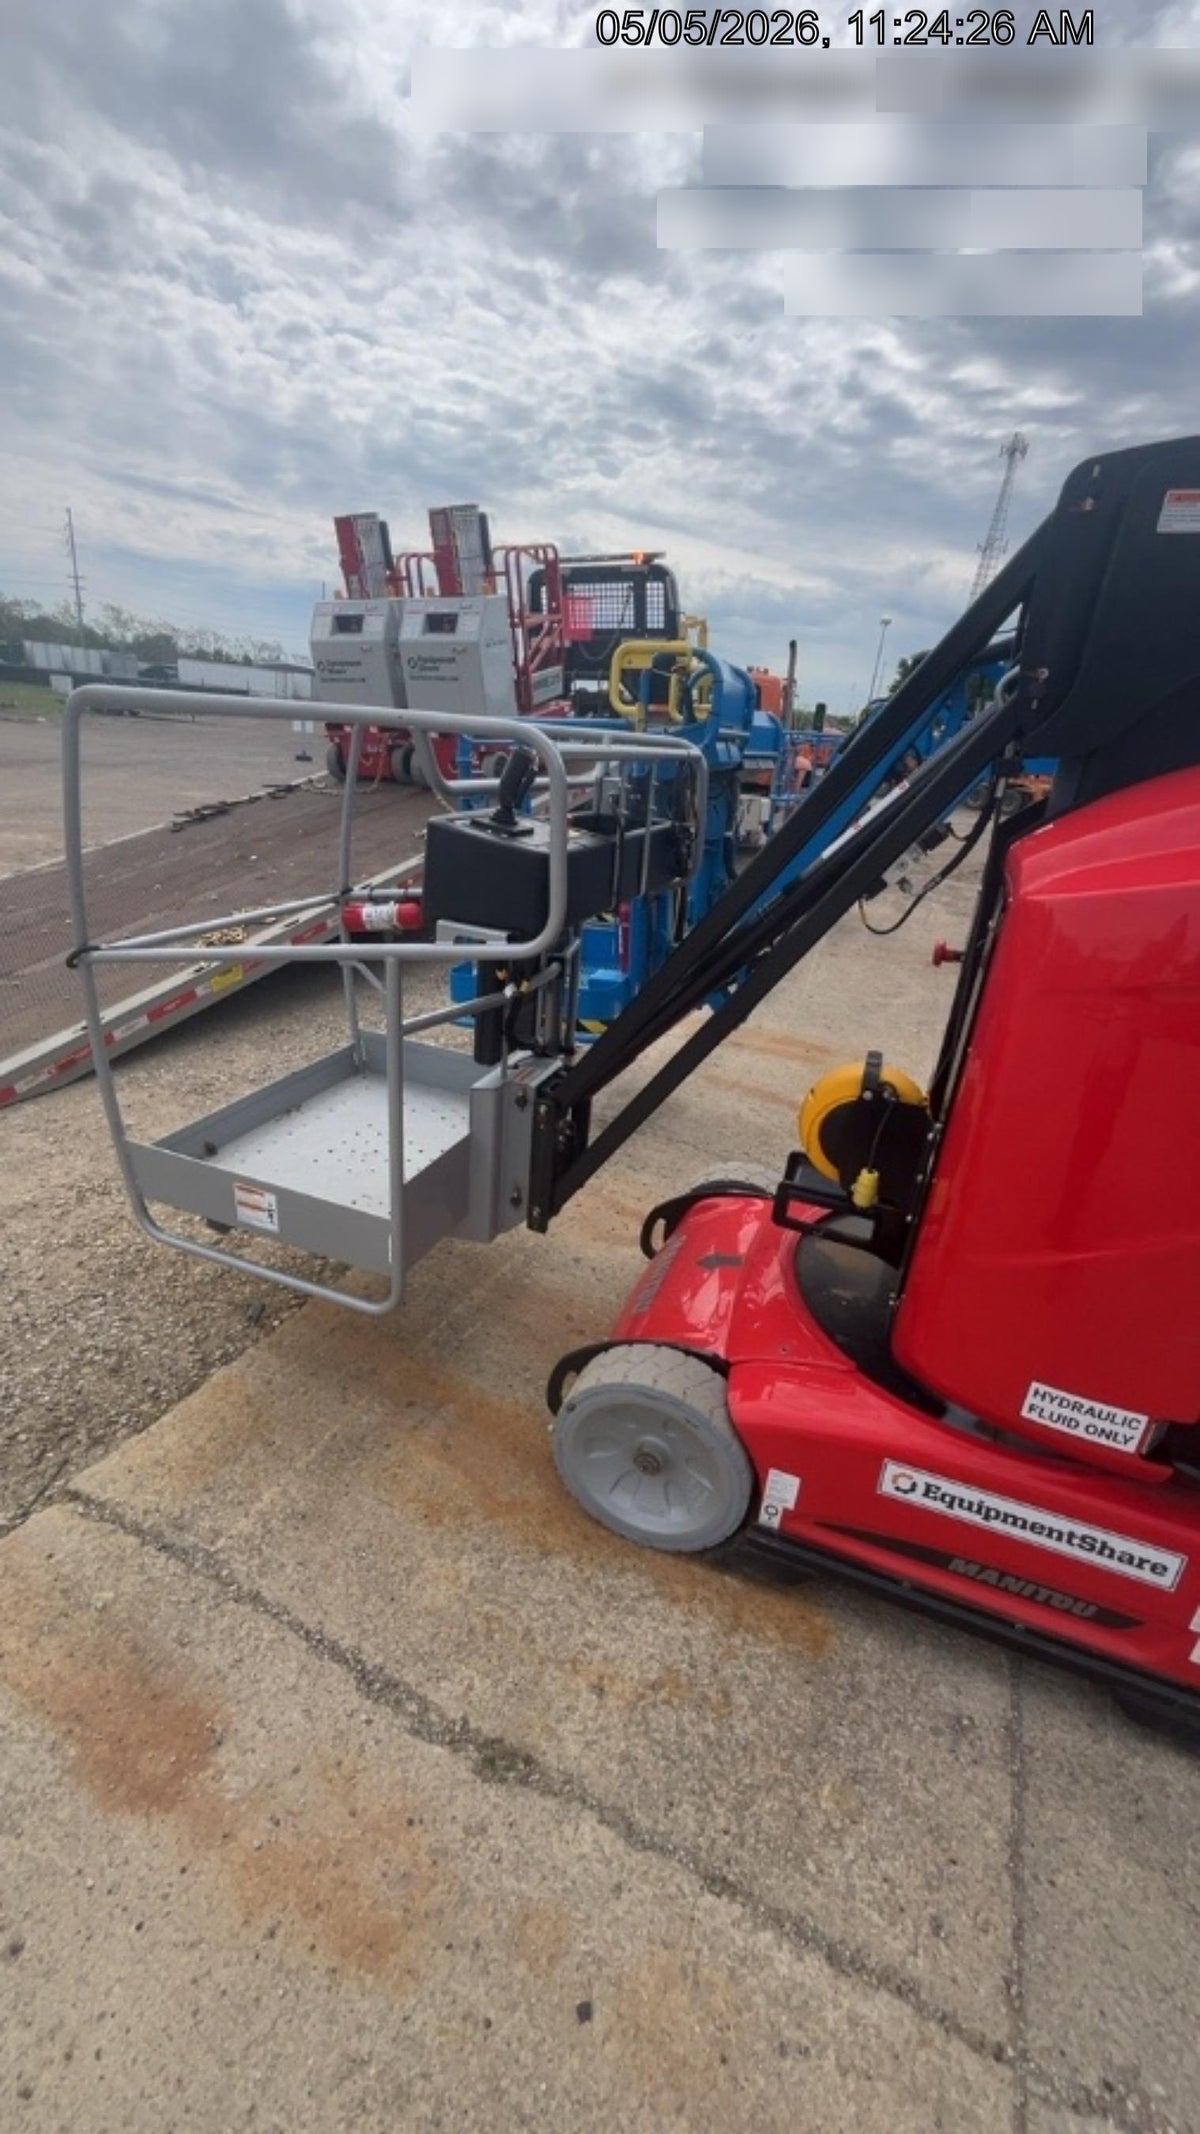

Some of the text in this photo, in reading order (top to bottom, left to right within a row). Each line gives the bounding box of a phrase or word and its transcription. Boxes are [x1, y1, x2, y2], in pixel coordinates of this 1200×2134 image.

[1028, 1403, 1135, 1446] FLUID ONLY
[1032, 1387, 1142, 1431] HYDRAULIC
[921, 1480, 1169, 1578] EquipmentShare
[949, 1557, 1099, 1618] MANITOU
